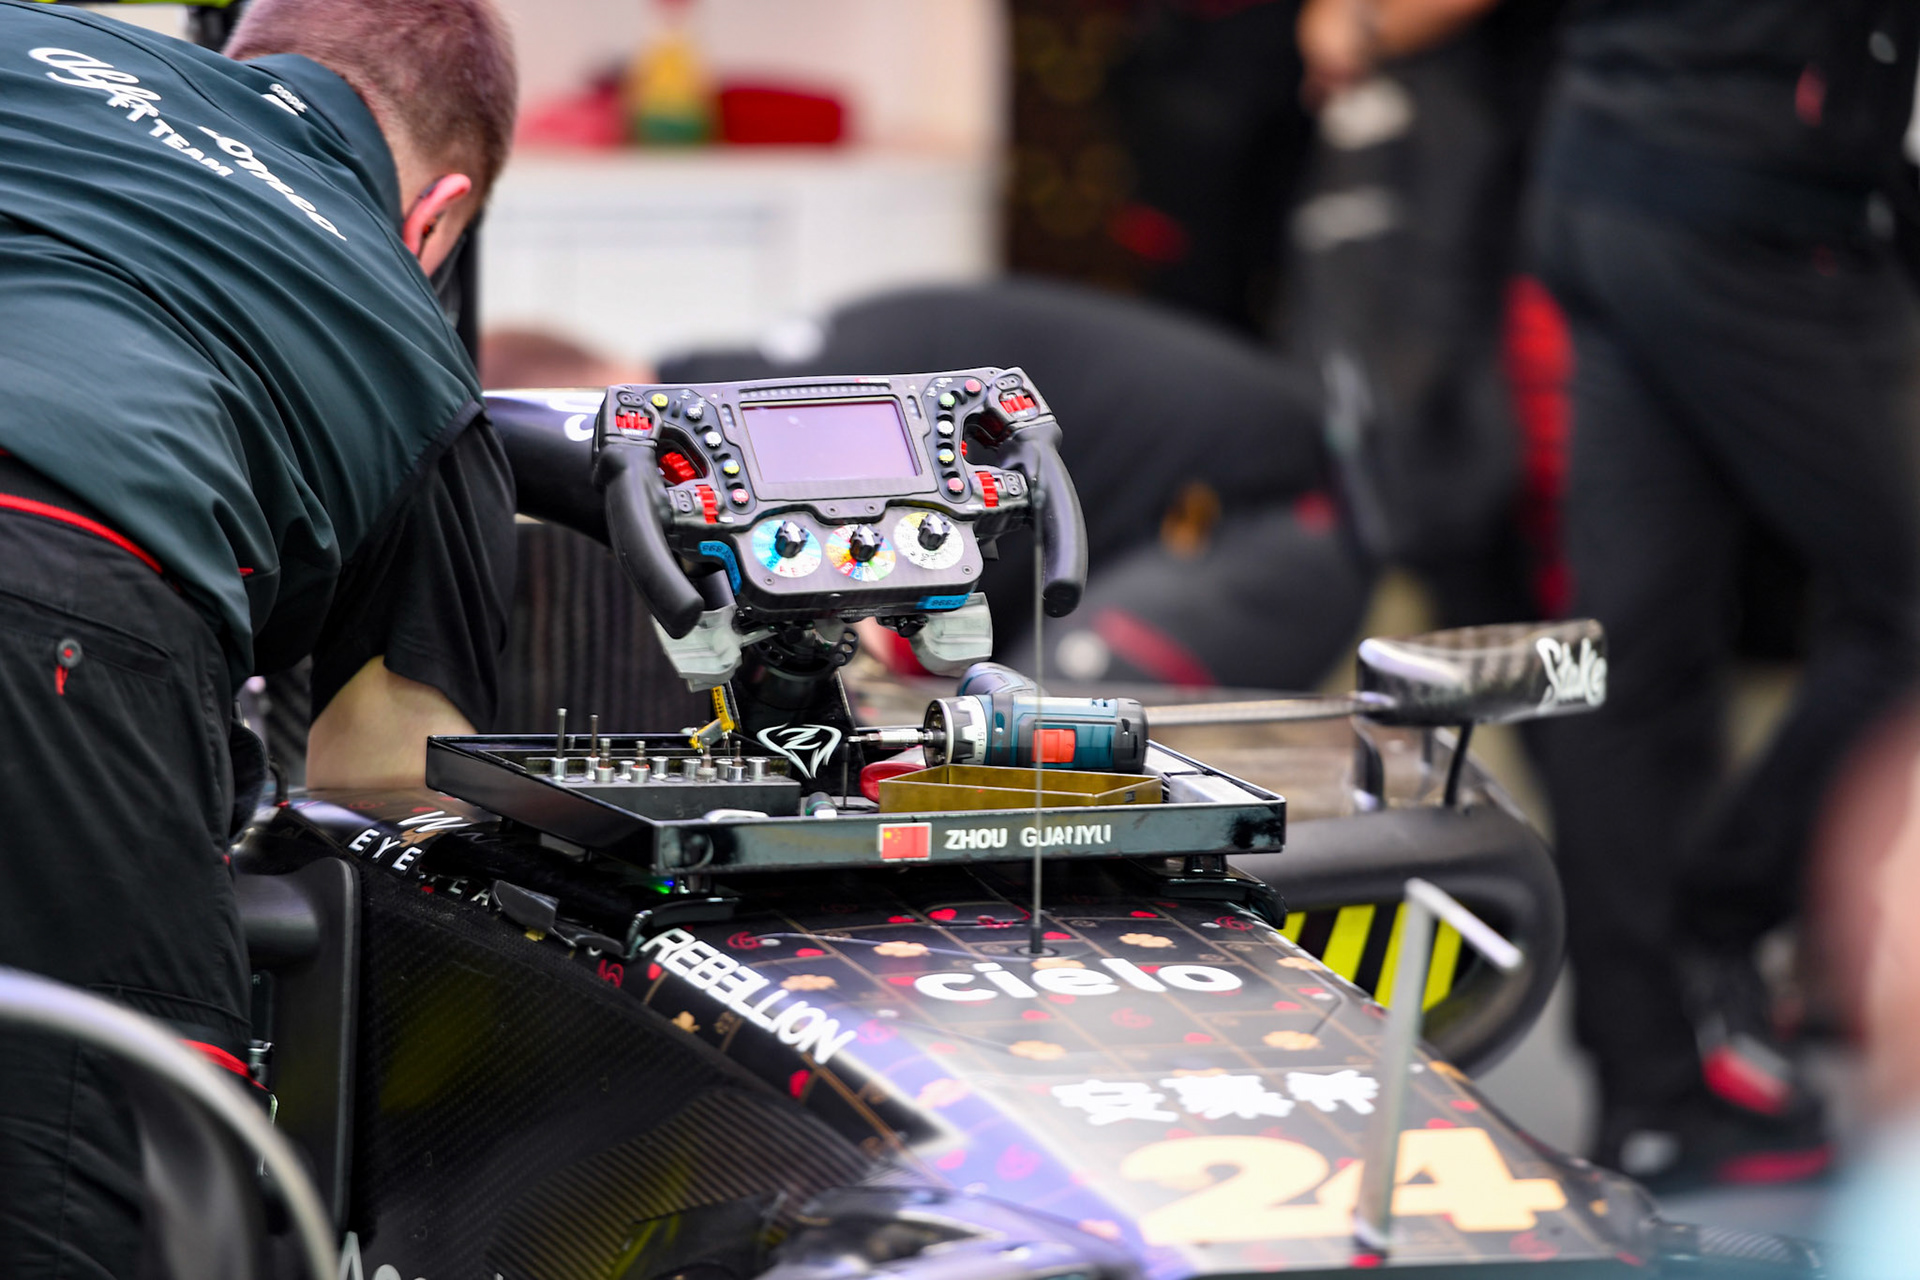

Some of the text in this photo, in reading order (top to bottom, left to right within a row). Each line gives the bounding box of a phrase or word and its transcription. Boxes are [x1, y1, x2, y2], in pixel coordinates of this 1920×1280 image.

[148, 118, 233, 177] TEAM
[197, 125, 347, 241] Romeo
[944, 828, 1008, 850] ZHOU
[913, 958, 1243, 1001] cielo
[1119, 1127, 1567, 1245] 24
